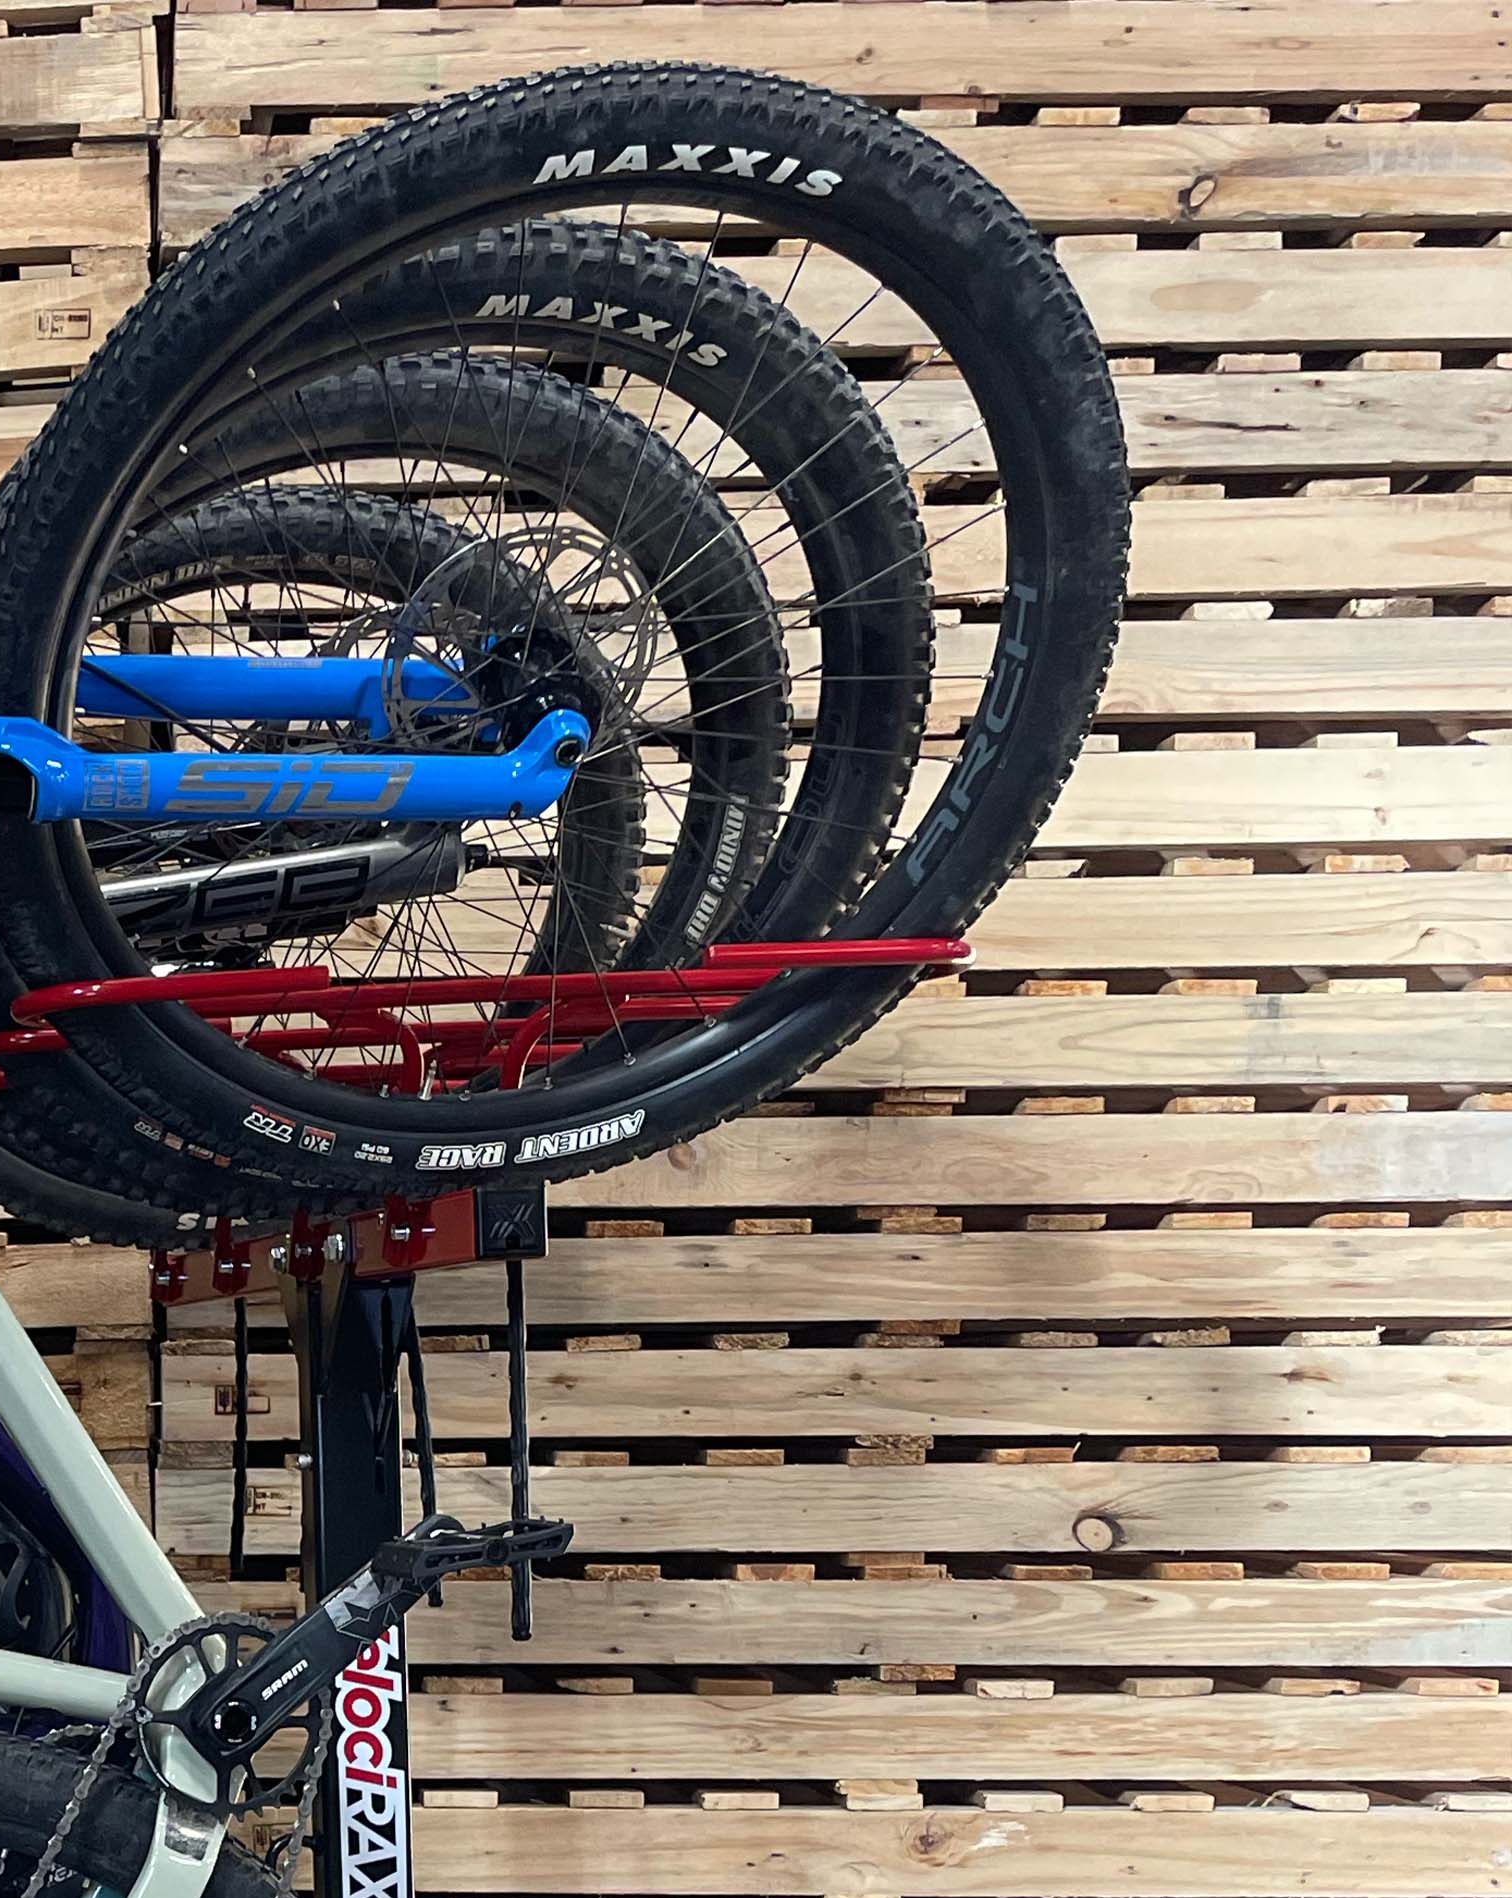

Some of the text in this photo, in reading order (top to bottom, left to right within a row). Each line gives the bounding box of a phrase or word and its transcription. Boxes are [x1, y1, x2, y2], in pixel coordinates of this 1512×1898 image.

[533, 144, 844, 197] MAXXIS
[475, 293, 728, 368] MAXXIS
[906, 581, 1038, 887] ARCH
[242, 1111, 294, 1144] TR
[300, 1131, 334, 1155] EXO
[415, 1108, 646, 1170] ARDENT RACE
[261, 1658, 309, 1701] SRAM
